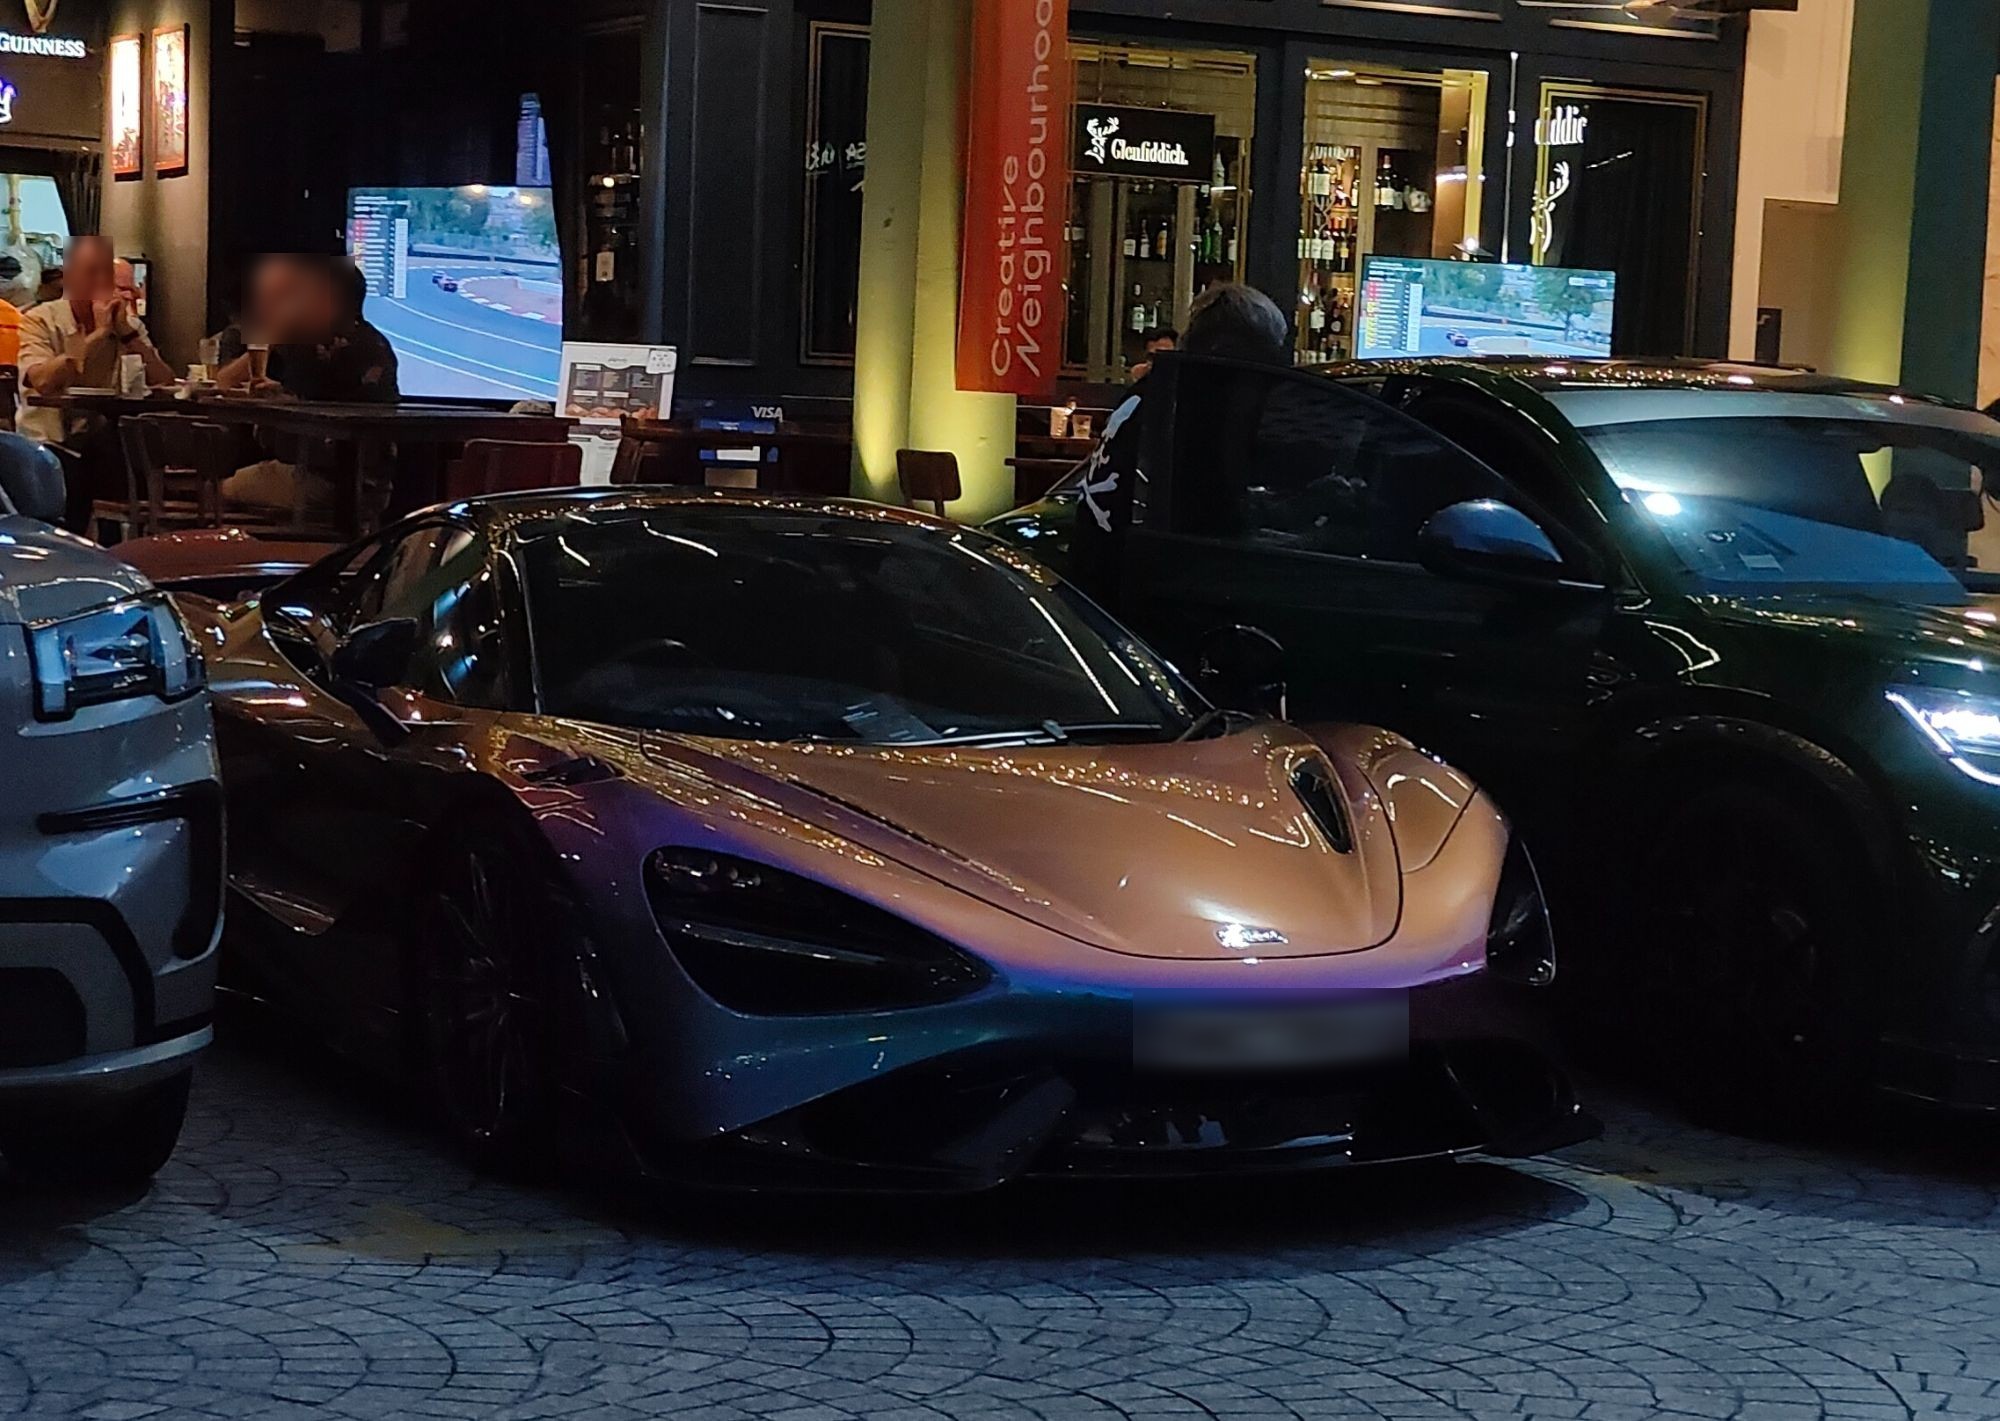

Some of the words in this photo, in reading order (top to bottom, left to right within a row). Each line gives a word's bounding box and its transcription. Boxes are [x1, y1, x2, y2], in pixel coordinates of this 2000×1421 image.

[0, 32, 86, 58] GUINNESS
[991, 155, 1019, 377] Creative
[751, 406, 783, 423] VISA
